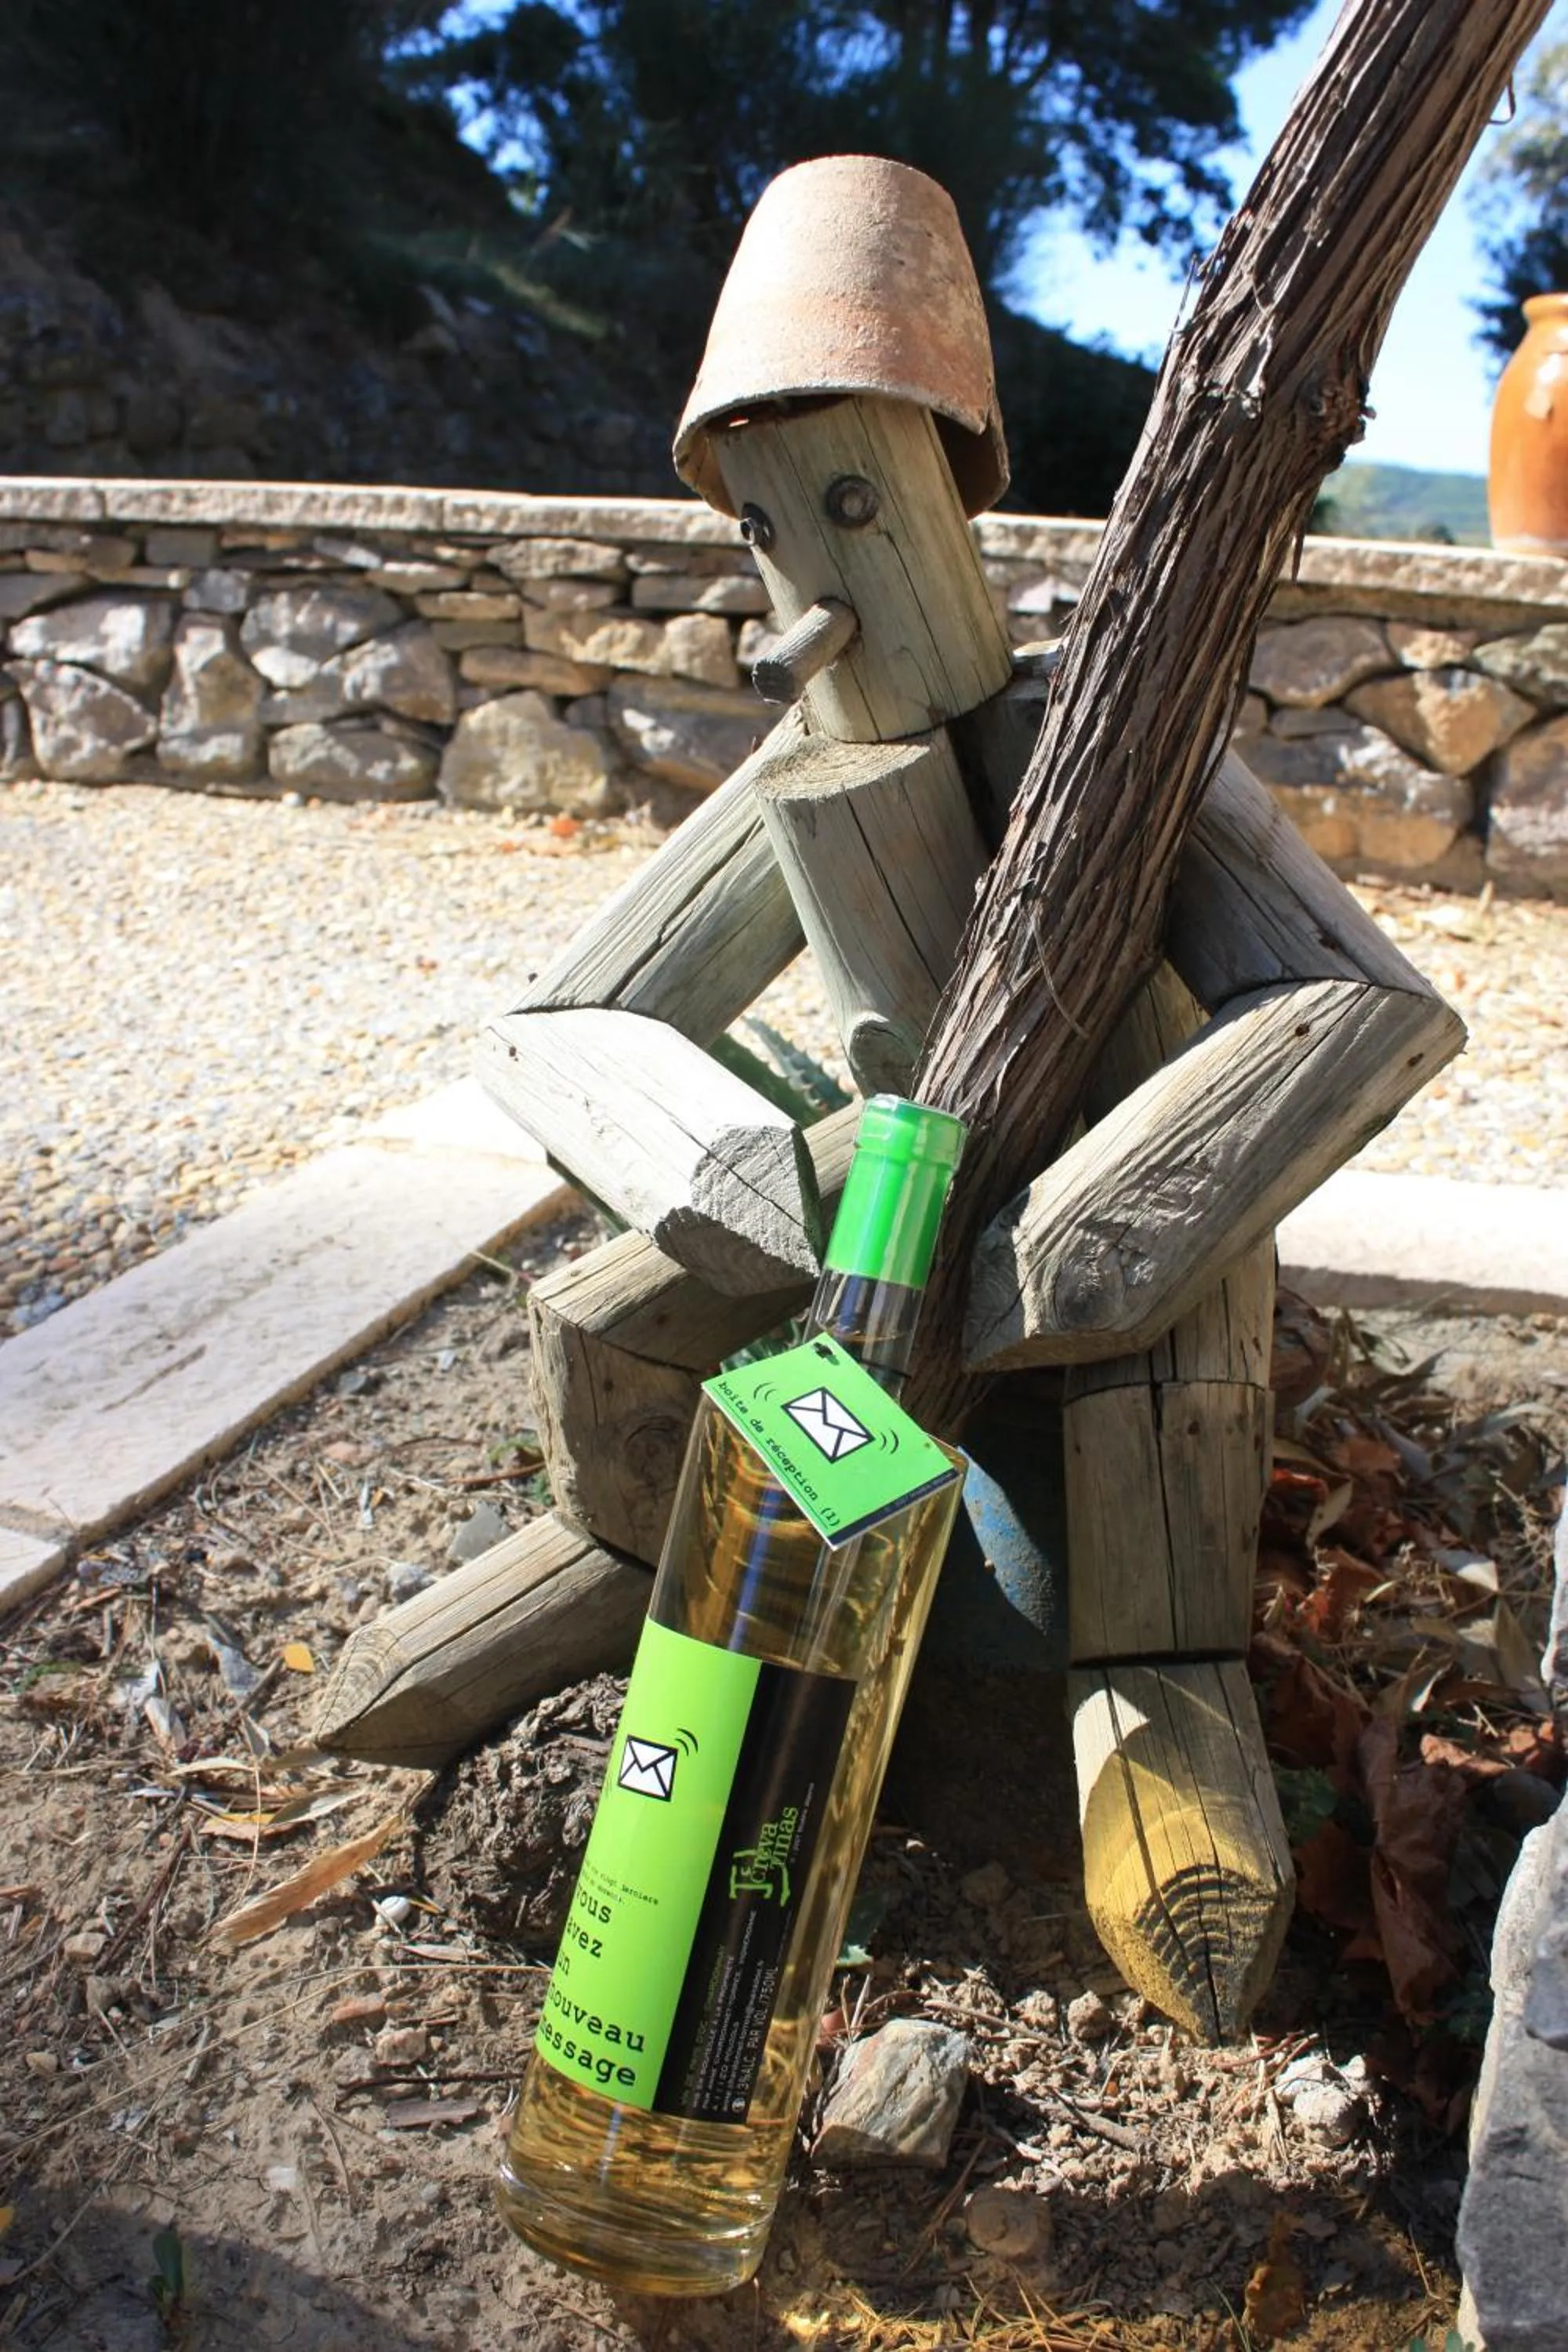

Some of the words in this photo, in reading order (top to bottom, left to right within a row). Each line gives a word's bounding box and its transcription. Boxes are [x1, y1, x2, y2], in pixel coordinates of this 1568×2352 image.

[750, 1417, 764, 1434] de
[765, 1437, 818, 1502] réception
[820, 1508, 841, 1527] (1)
